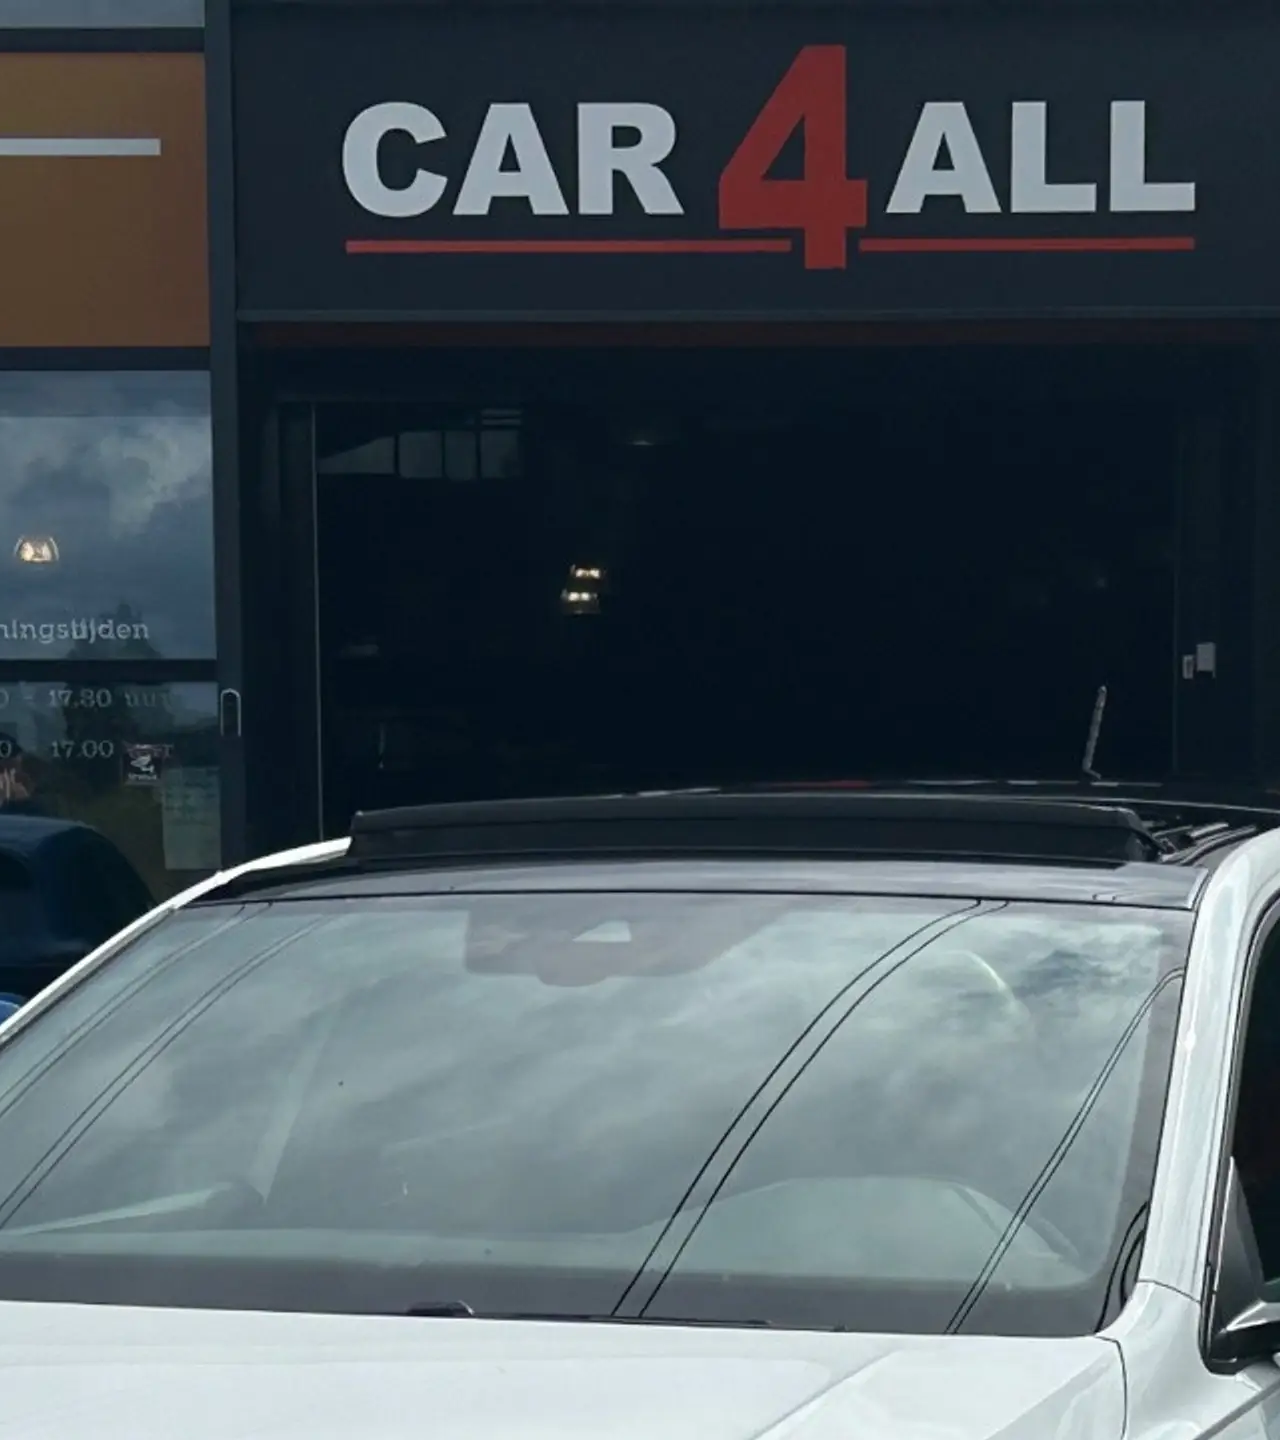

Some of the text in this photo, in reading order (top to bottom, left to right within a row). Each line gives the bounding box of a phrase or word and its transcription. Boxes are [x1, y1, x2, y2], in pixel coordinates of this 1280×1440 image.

[342, 44, 1196, 270] CAR 4 ALL
